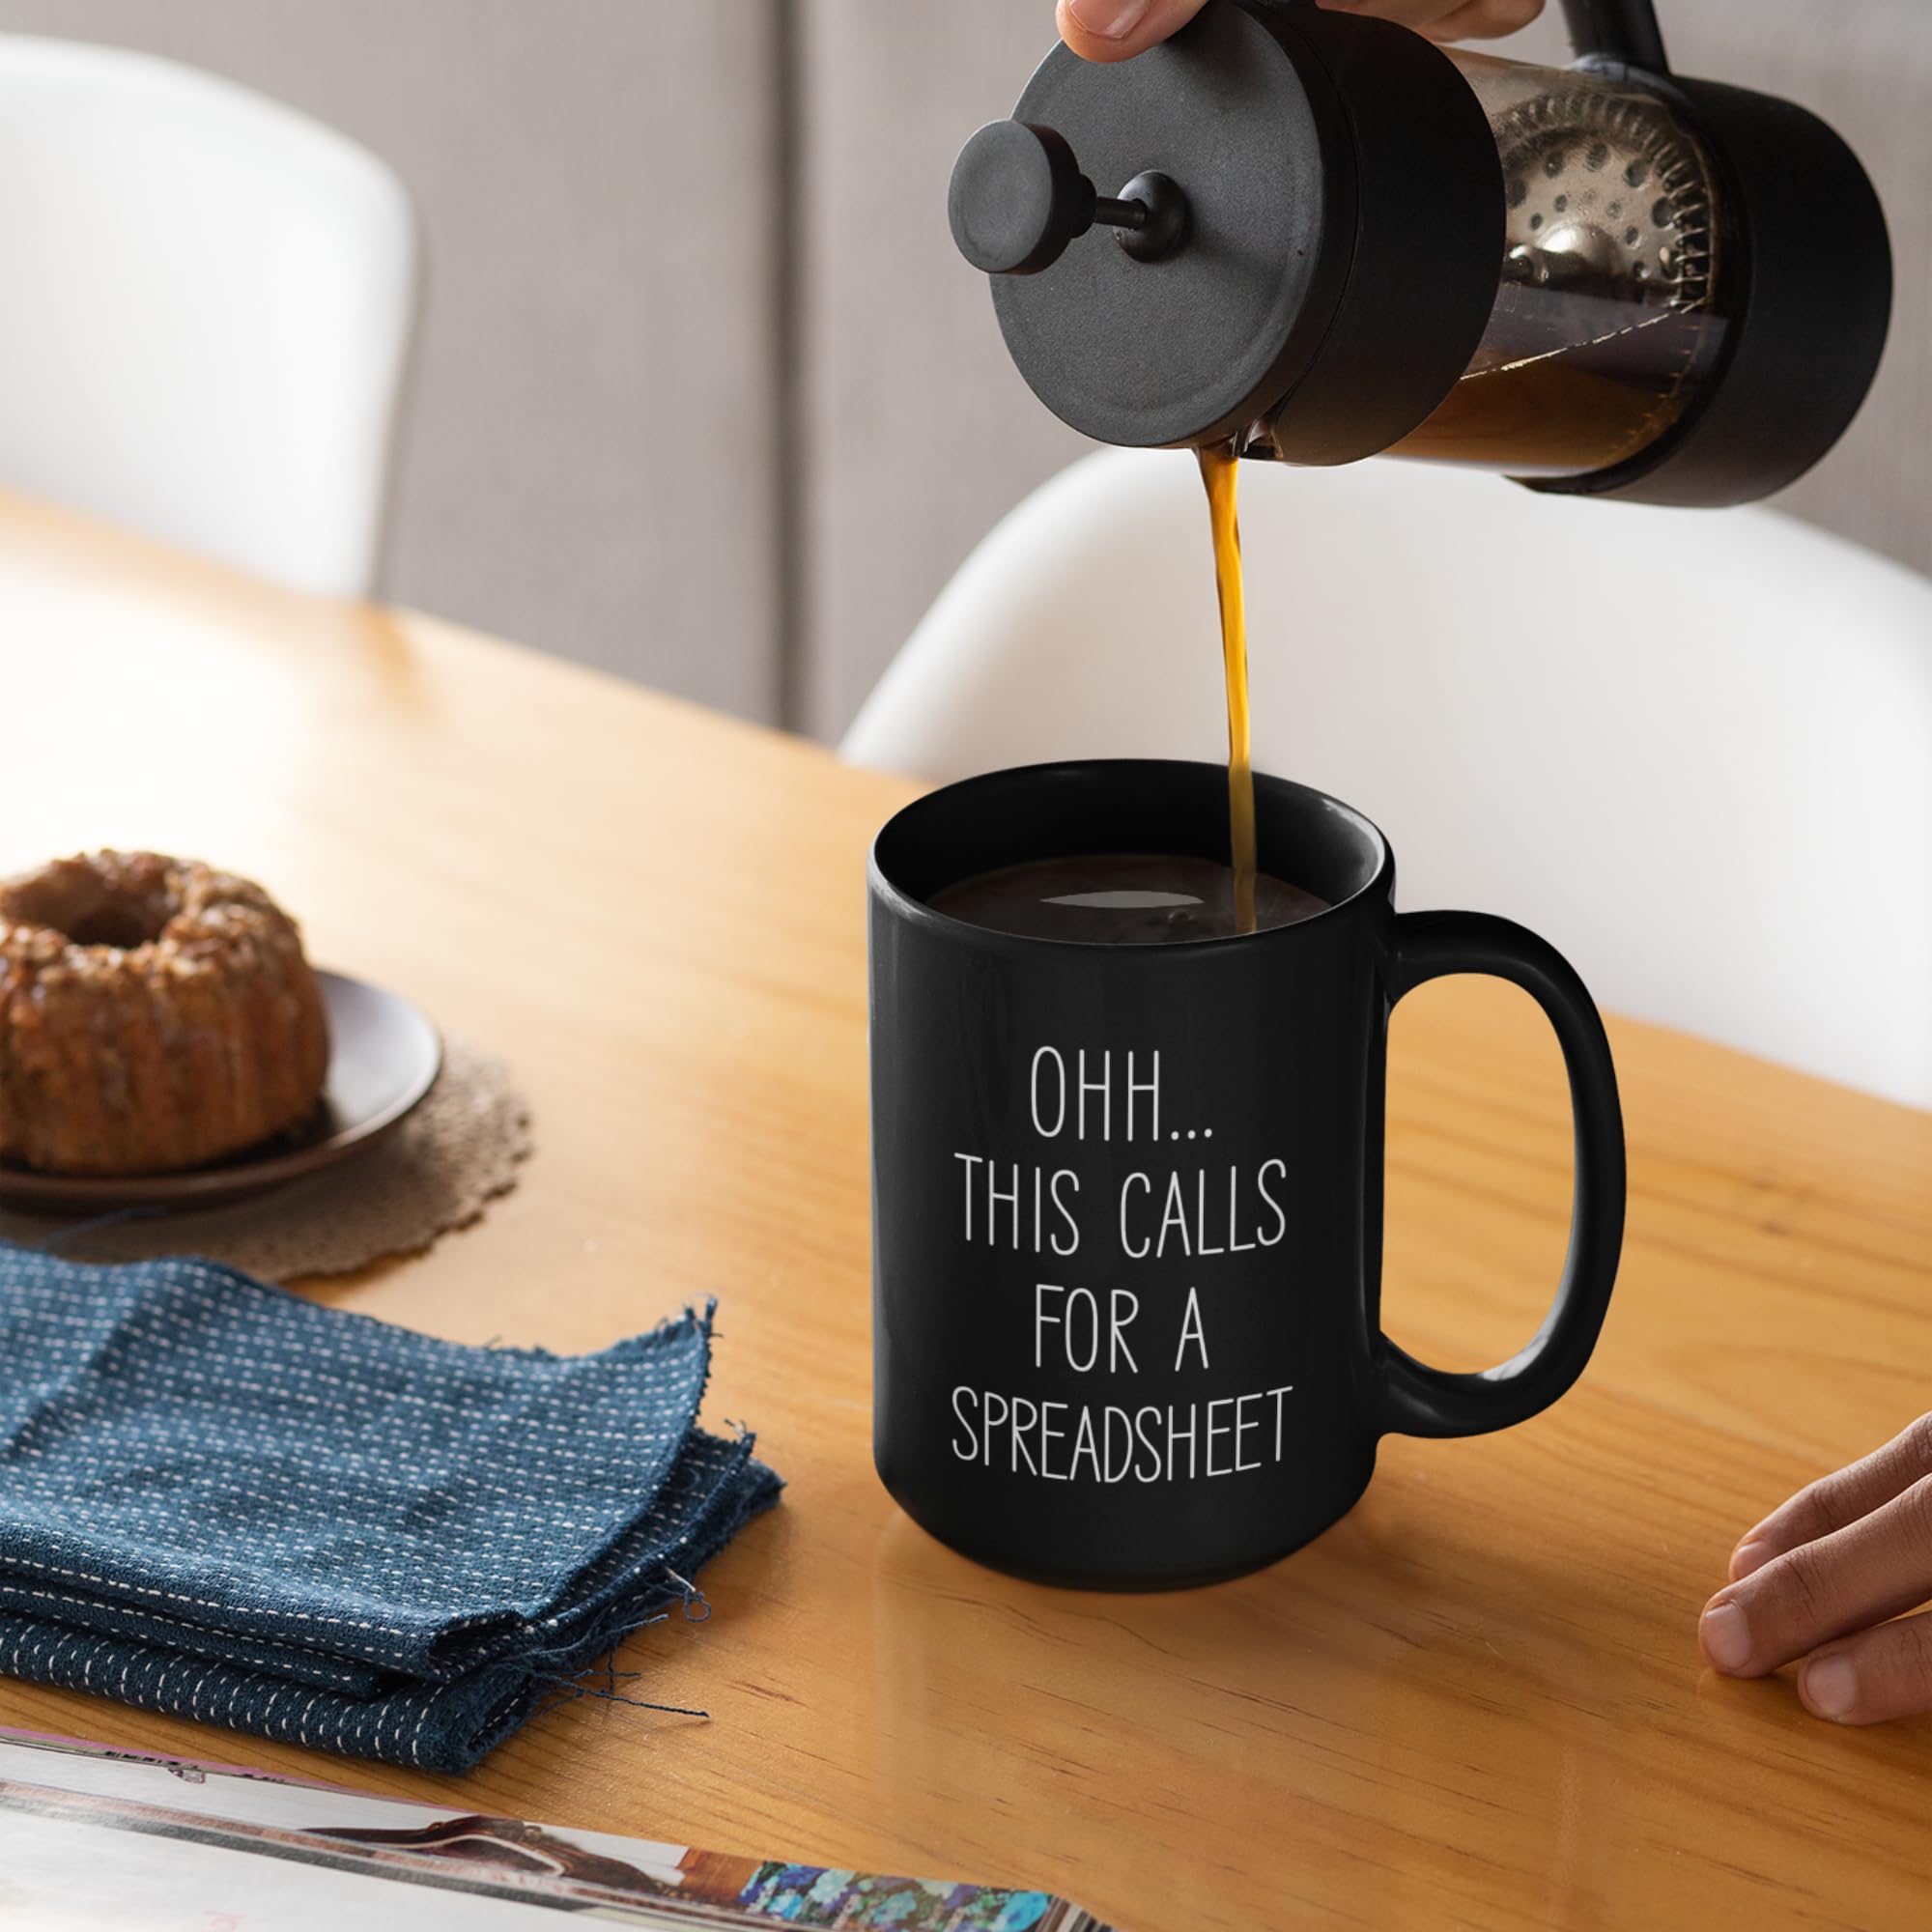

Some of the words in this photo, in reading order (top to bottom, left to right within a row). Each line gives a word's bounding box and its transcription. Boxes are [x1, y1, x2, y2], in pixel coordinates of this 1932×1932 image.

[1031, 1045, 1213, 1142] OHH...
[953, 1151, 1080, 1256] THIS
[1120, 1158, 1287, 1259] CALLS
[1035, 1283, 1139, 1374] FOR
[1174, 1286, 1209, 1373] A
[952, 1385, 1293, 1484] SPREADSHEET
